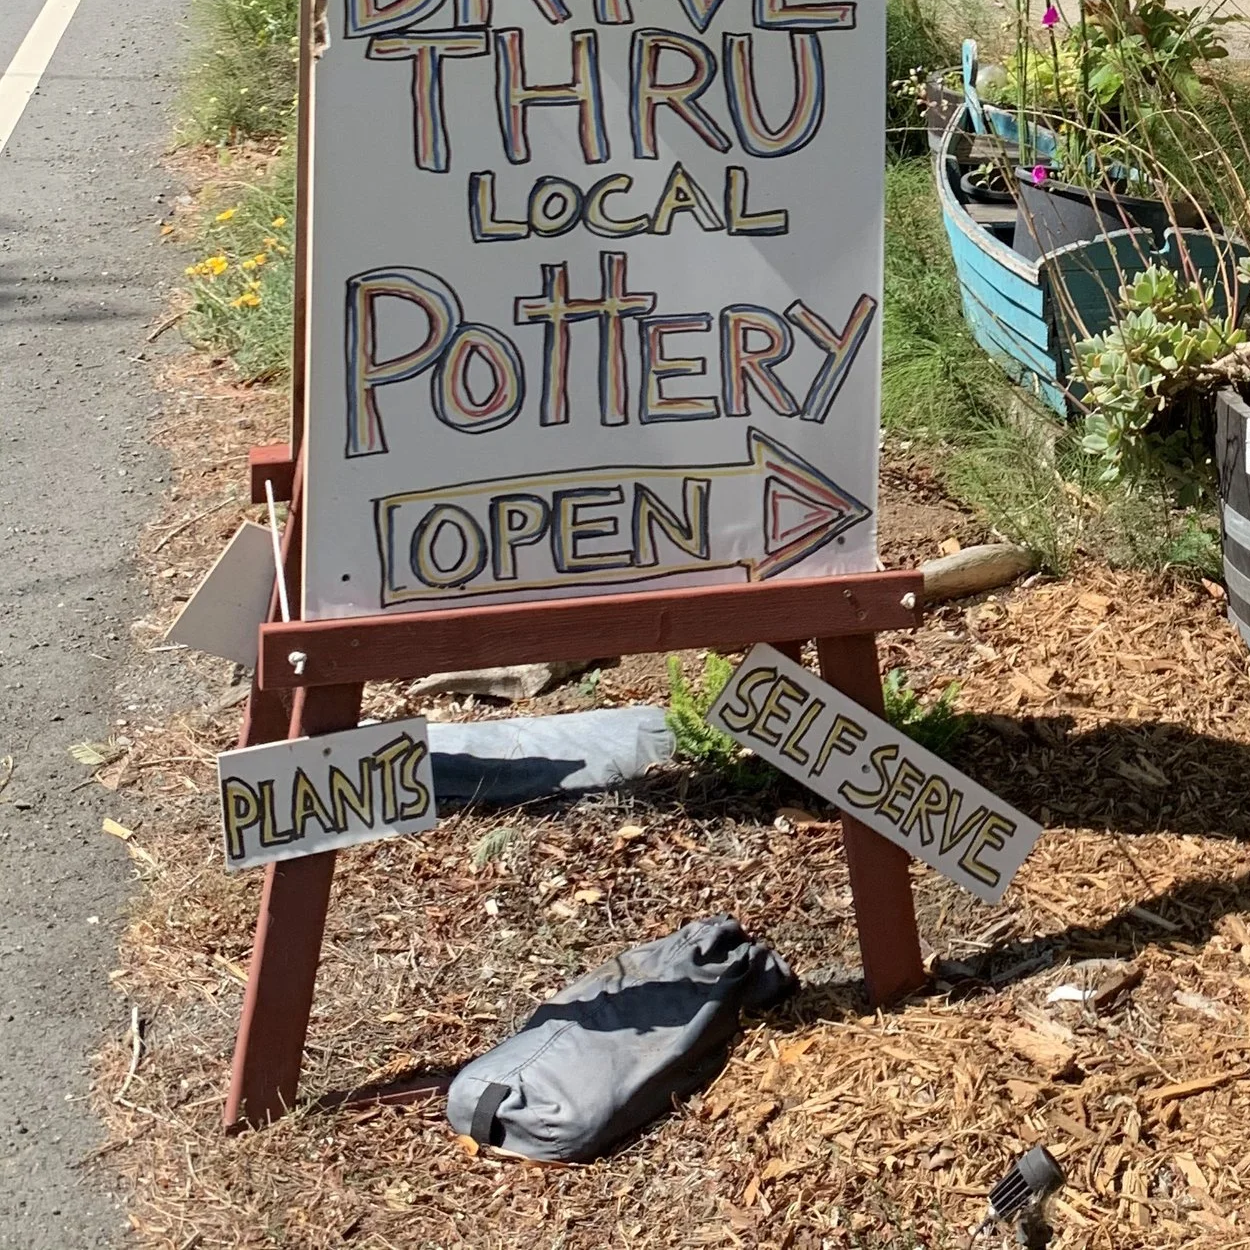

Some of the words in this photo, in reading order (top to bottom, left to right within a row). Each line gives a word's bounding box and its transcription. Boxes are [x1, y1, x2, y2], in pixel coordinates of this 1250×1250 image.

[366, 27, 825, 173] THRU
[468, 161, 789, 243] LOCAL
[410, 477, 712, 588] OPEN
[221, 731, 430, 859] PLANTS
[718, 666, 868, 779] SELF
[837, 744, 1018, 888] SERVE
